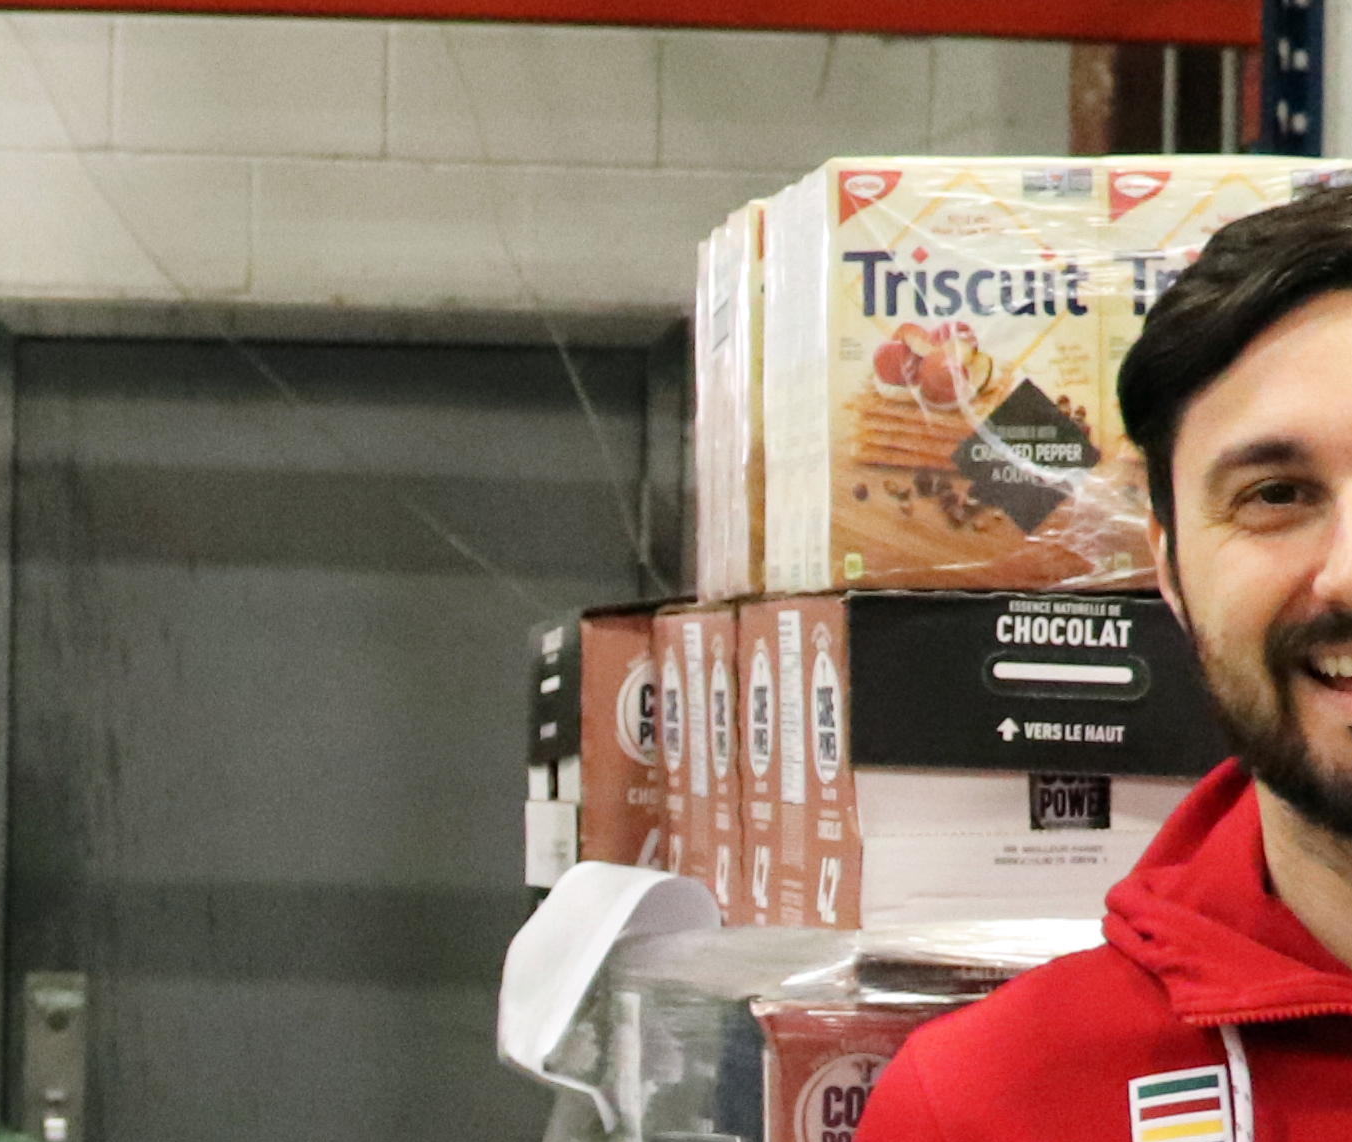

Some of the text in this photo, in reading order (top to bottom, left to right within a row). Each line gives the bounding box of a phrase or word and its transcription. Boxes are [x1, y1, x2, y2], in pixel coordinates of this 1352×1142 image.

[841, 246, 1089, 317] Triscuit
[1035, 443, 1083, 462] PEPPER
[996, 615, 1133, 648] CHOCOLAT
[1024, 722, 1125, 743] VERS LE HAUT
[821, 1085, 870, 1128] CO
